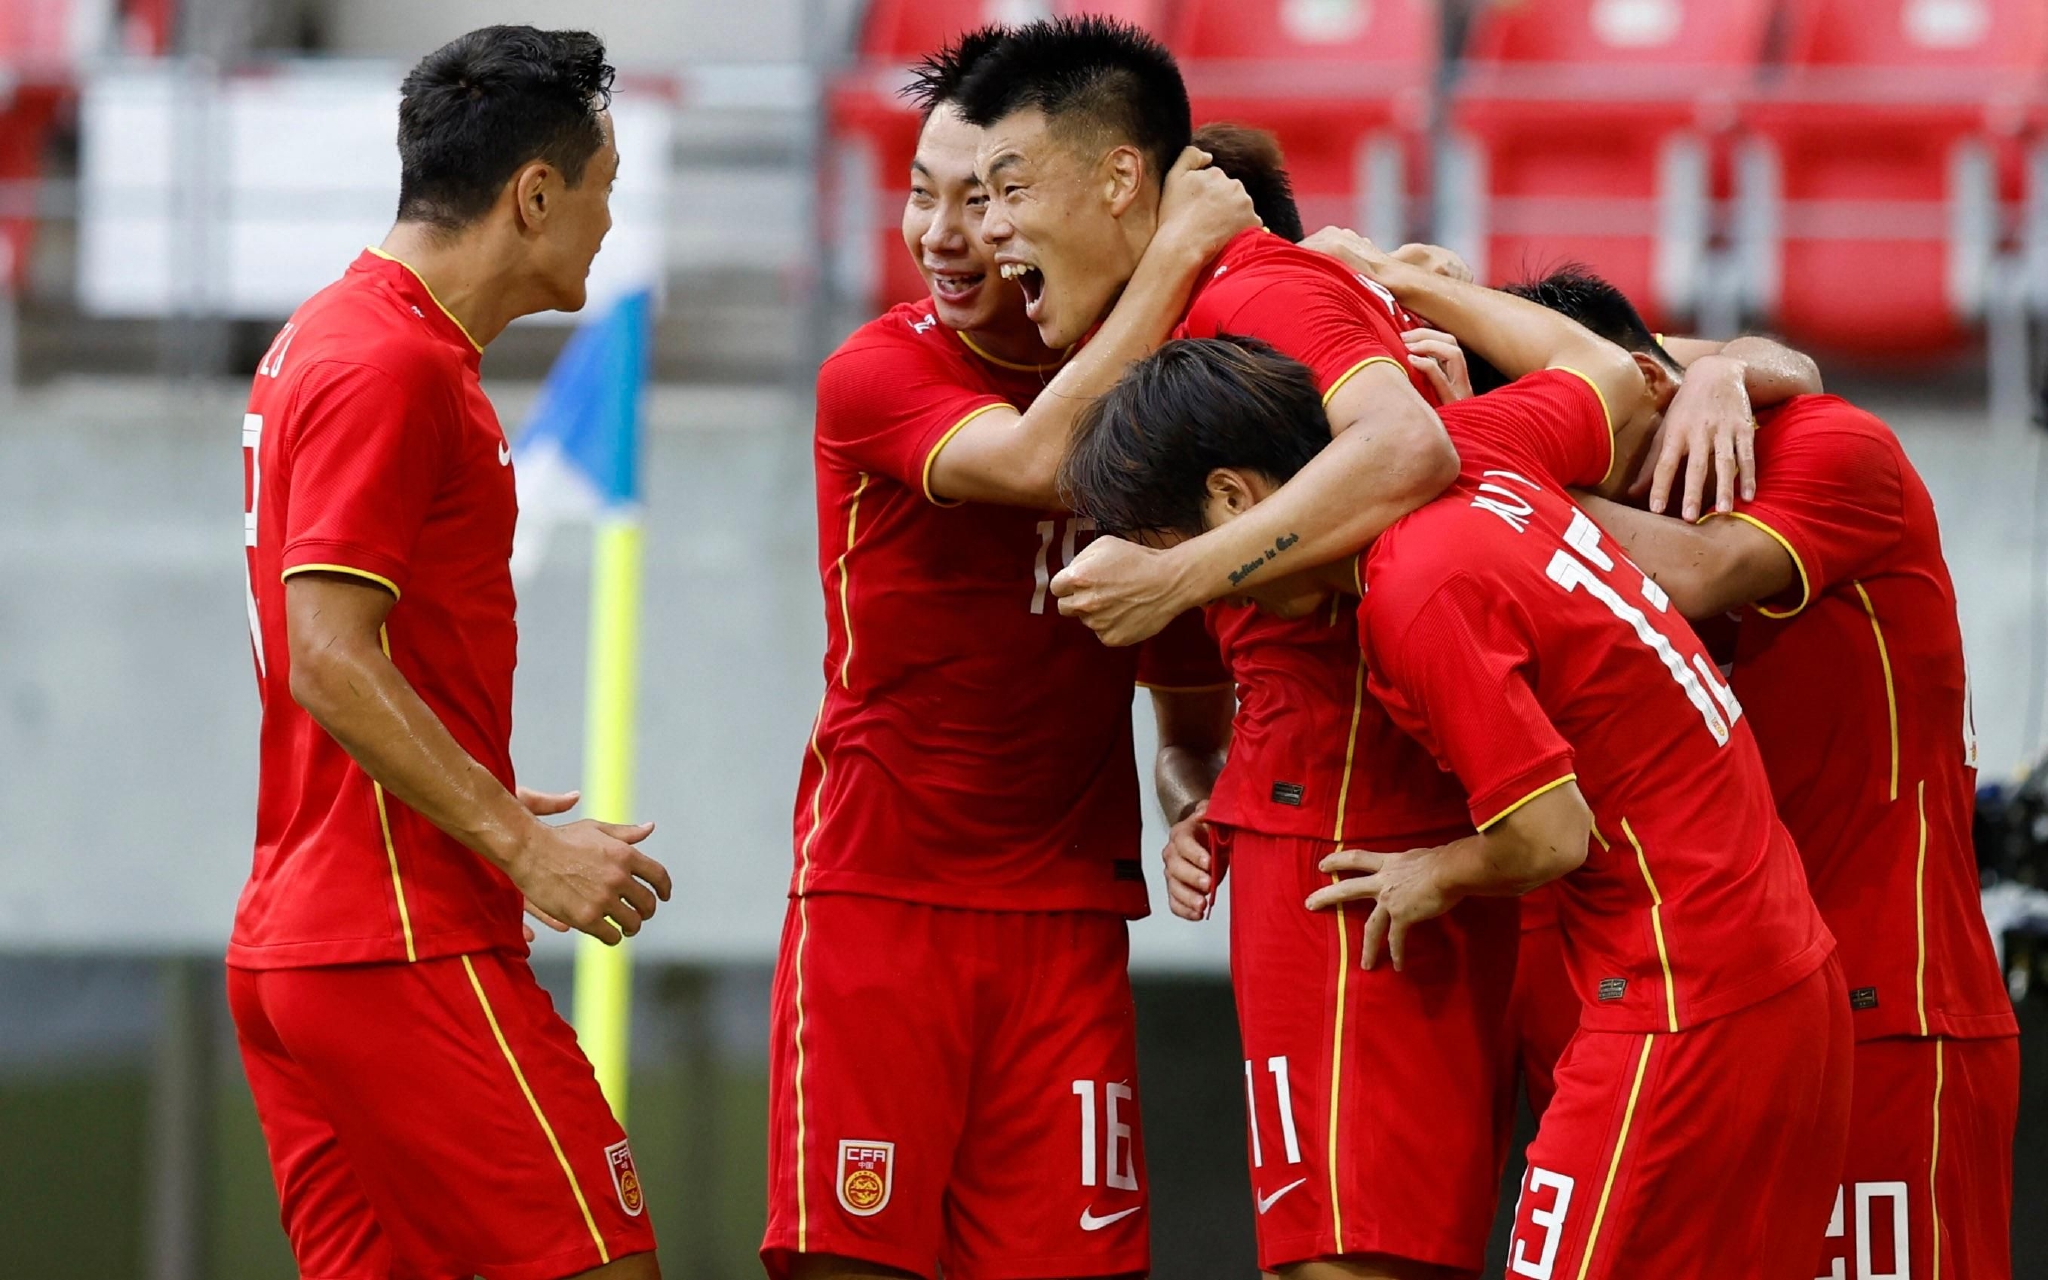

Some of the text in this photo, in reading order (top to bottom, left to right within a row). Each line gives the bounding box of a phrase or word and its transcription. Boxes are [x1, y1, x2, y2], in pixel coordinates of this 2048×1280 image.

[847, 1148, 886, 1162] CFA
[1072, 1079, 1138, 1191] 16
[1245, 1056, 1301, 1168] 11
